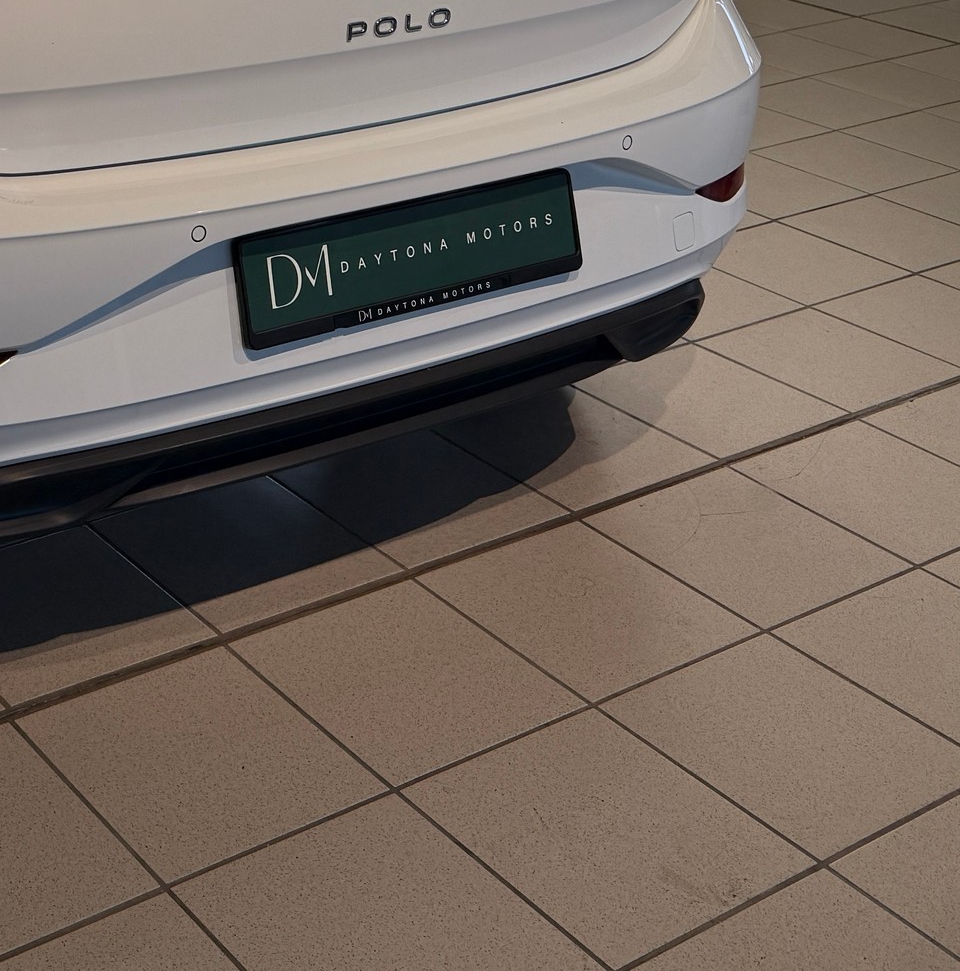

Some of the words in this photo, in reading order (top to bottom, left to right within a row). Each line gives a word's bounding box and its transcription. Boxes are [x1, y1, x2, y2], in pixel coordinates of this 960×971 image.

[346, 7, 452, 43] POLO
[340, 237, 449, 274] DAYTONA
[466, 213, 553, 245] MOTORS
[266, 244, 333, 310] DM
[377, 295, 434, 316] DAYTONA
[442, 281, 491, 299] MOTORS
